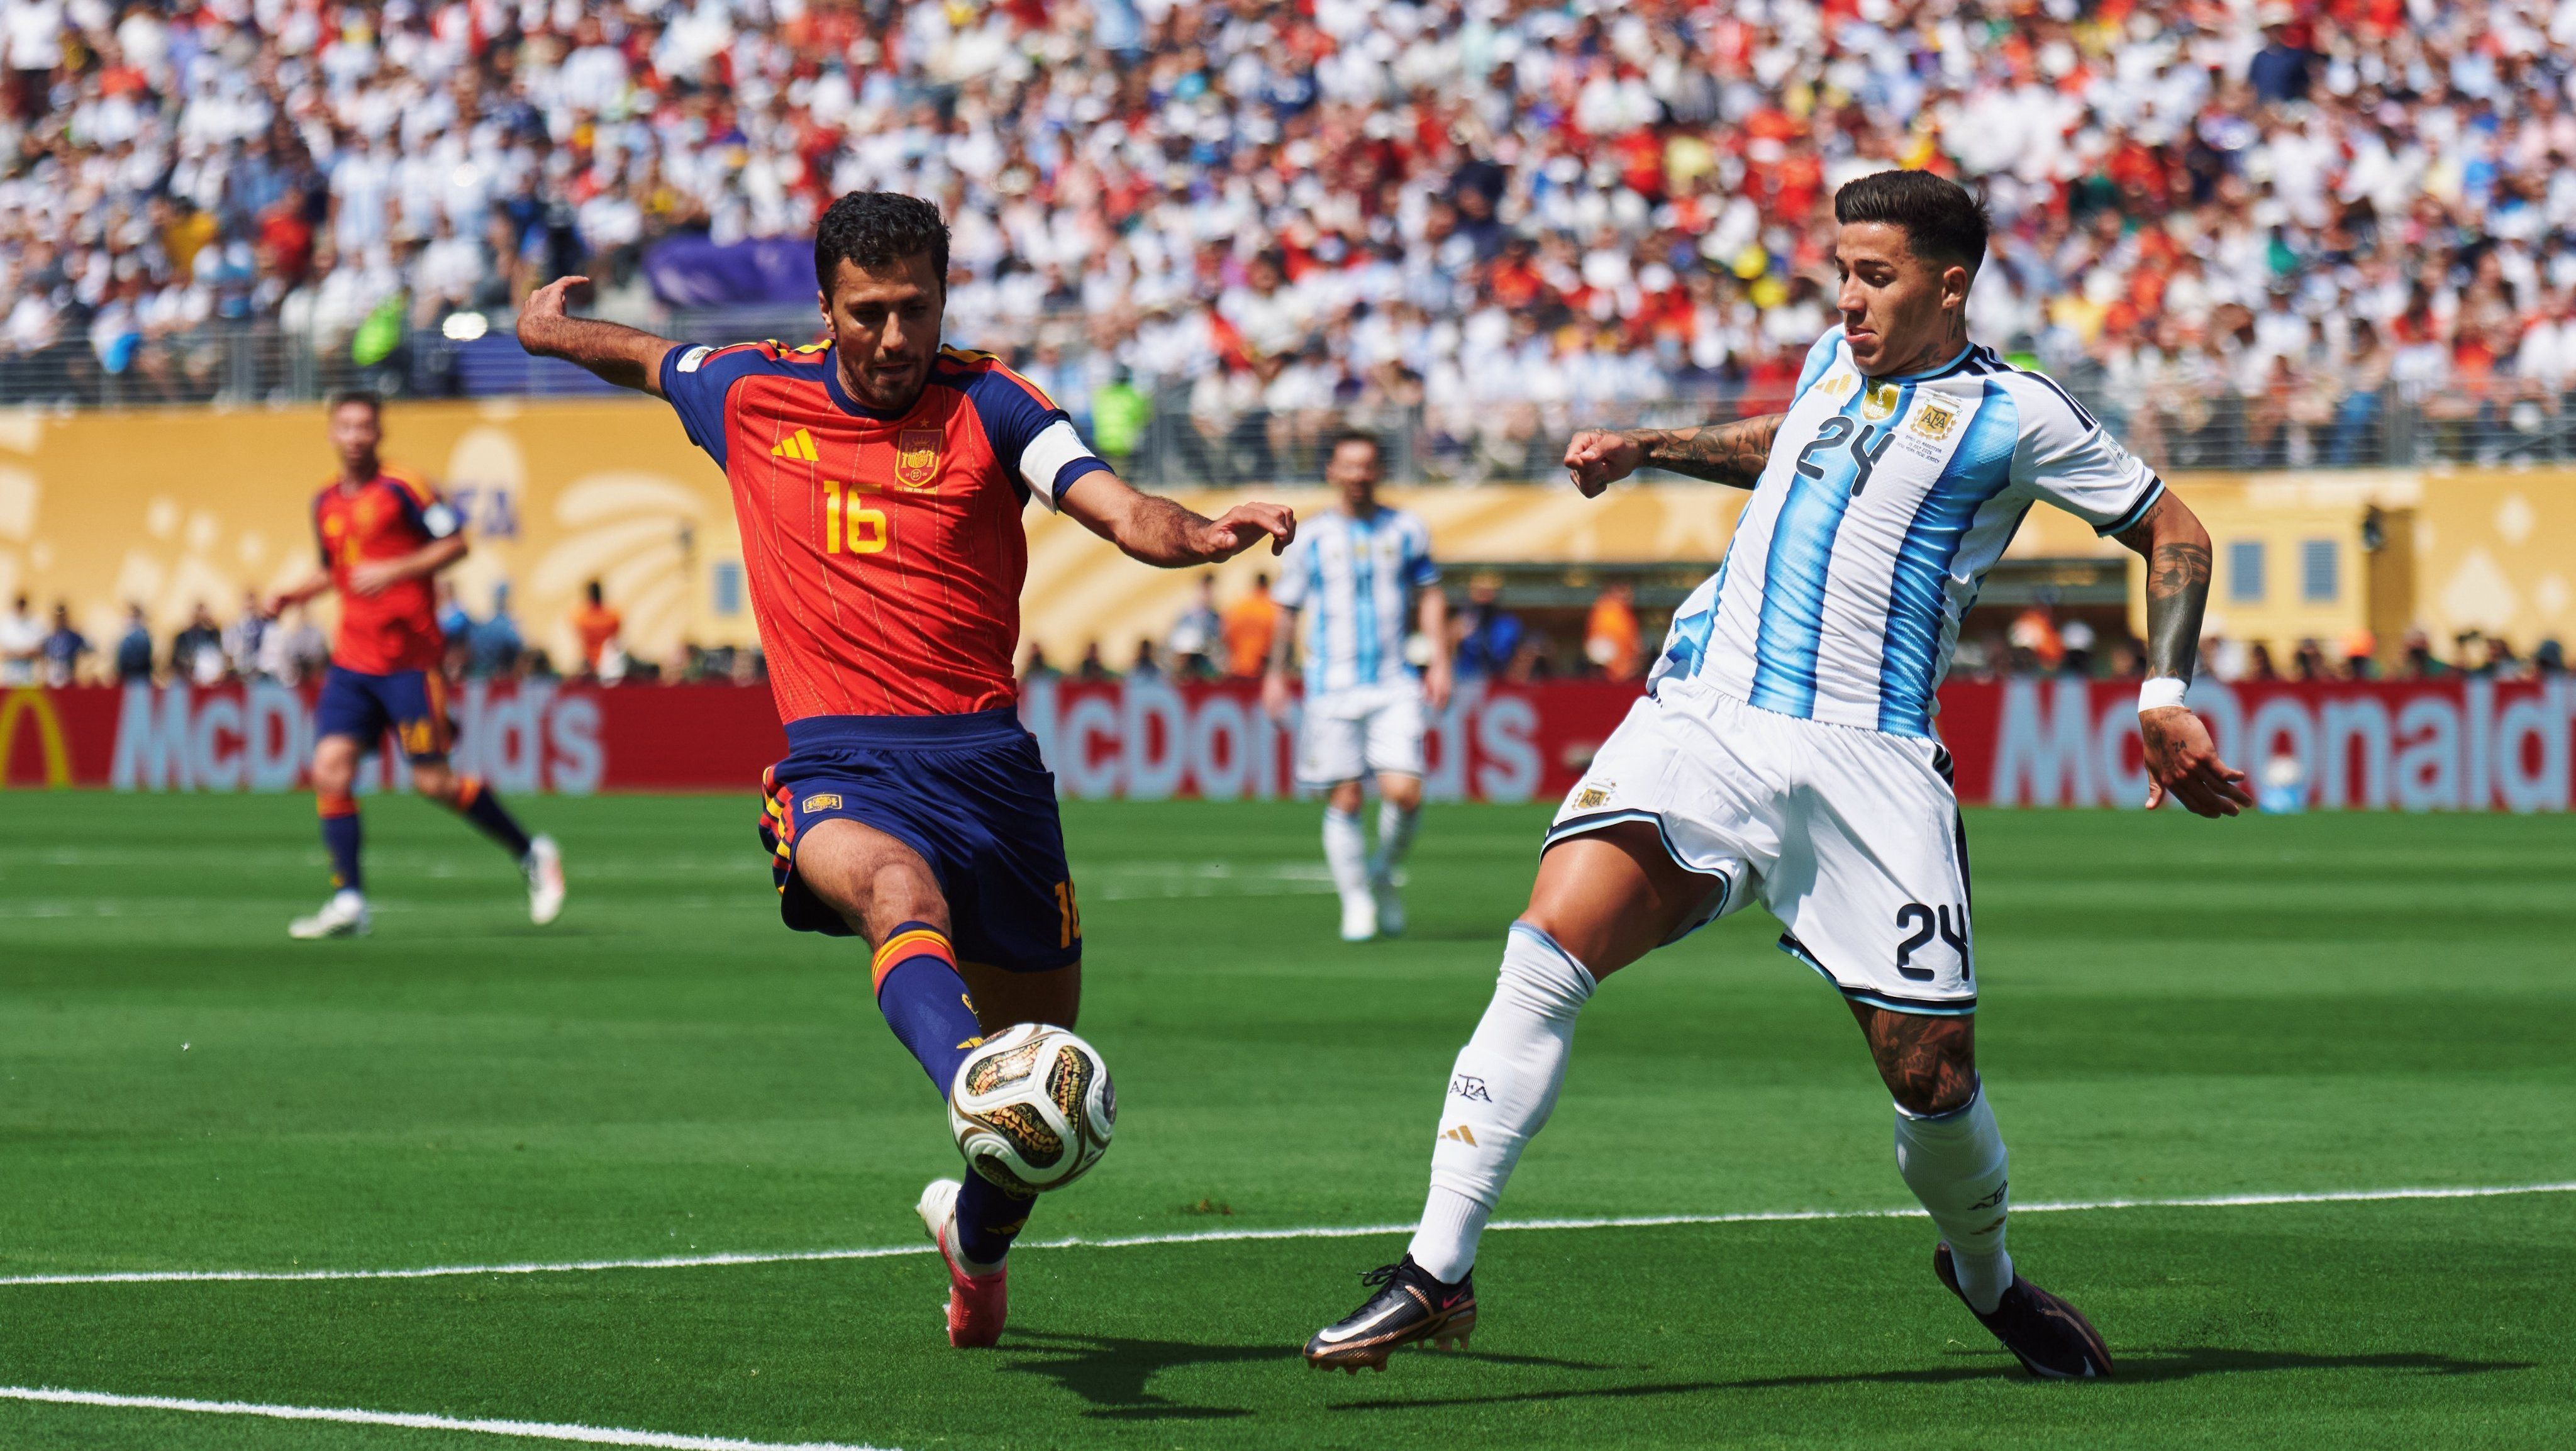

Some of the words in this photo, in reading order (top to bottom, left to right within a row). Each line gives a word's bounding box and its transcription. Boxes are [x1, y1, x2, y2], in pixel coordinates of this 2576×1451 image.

[1921, 408, 1948, 429] AFA
[1796, 416, 1896, 497] 24
[823, 481, 887, 553] 16
[1896, 903, 1970, 982] 24
[1448, 1073, 1493, 1103] AFA
